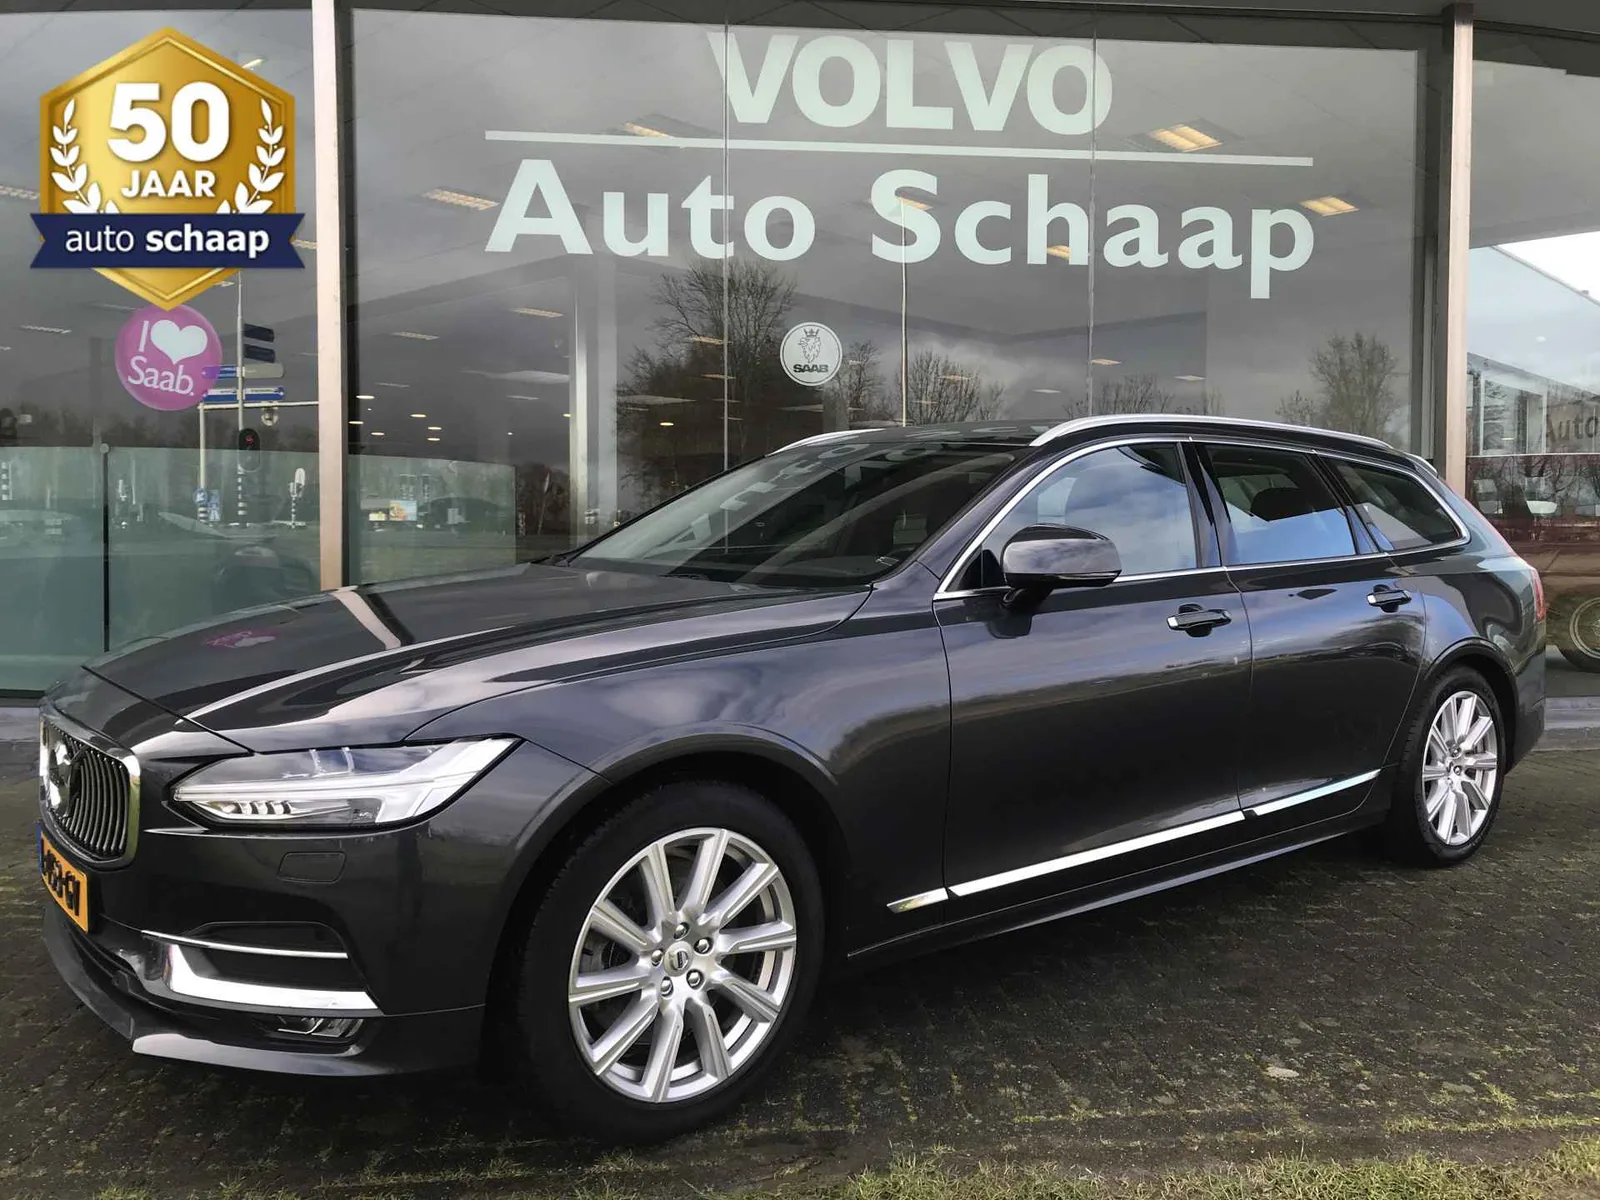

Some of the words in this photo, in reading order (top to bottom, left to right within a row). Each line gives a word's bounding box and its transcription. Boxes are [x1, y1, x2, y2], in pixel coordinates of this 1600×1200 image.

[706, 32, 1113, 136] VOLVO
[485, 159, 816, 261] Auto
[870, 169, 1314, 299] Schaap
[138, 320, 149, 352] I
[793, 363, 829, 373] SAAB
